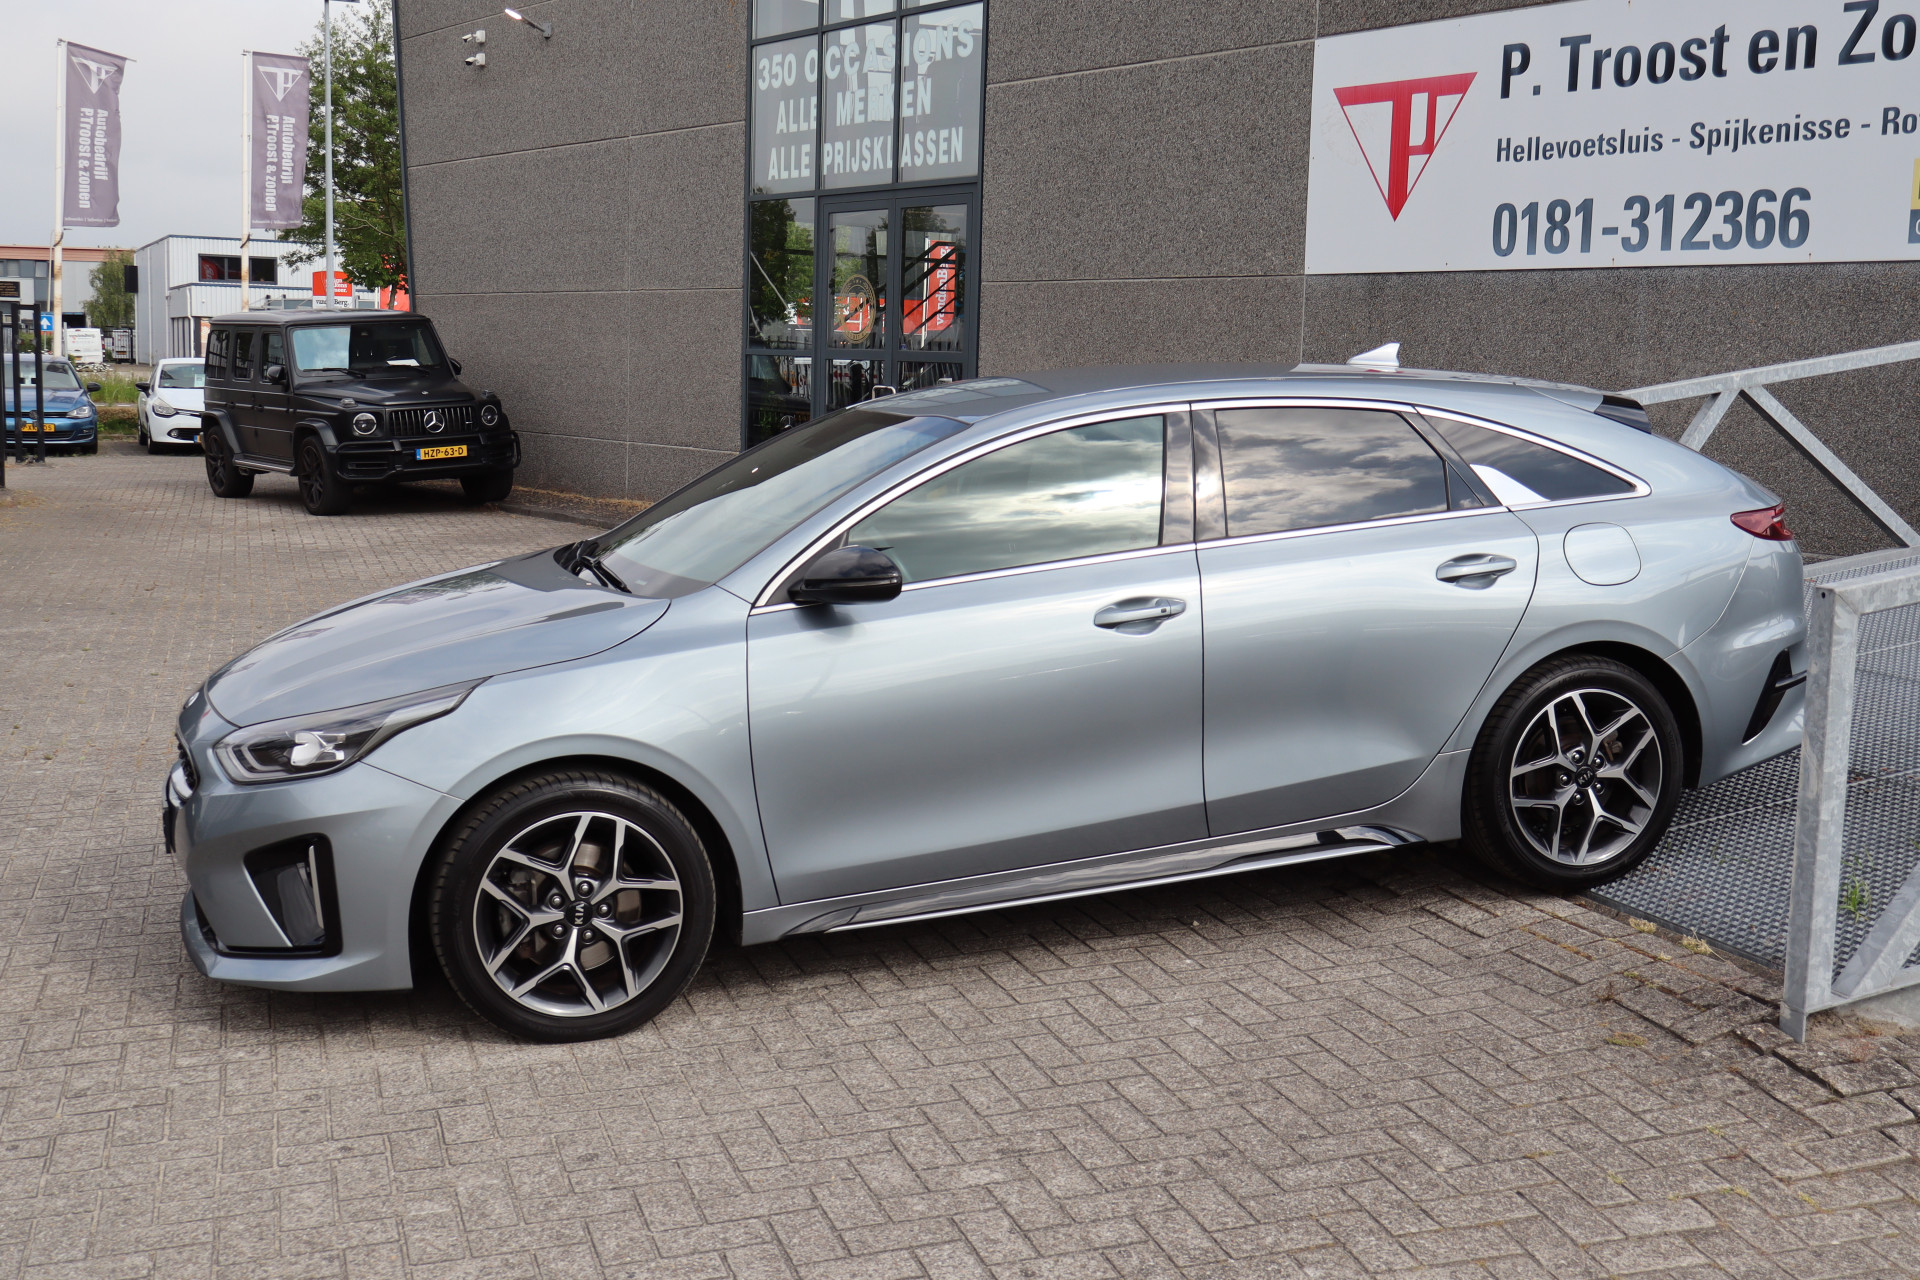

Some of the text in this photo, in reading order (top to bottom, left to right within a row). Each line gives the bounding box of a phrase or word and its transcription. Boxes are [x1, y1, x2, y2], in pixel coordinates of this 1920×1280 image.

[758, 20, 974, 91] 350 OCCASIONS
[1500, 0, 1917, 99] P. Troost en Zo
[776, 78, 932, 135] ALLE MERKEN
[1496, 126, 1663, 162] Hellevoetsluis
[1689, 114, 1850, 155] Spijkenisse
[1881, 106, 1920, 135] Ro
[95, 108, 108, 181] Autobedrijf
[266, 165, 277, 174] &
[282, 115, 295, 184] Autobedrijf
[768, 126, 963, 181] ALLE PRIJSKLASSEN
[265, 175, 277, 212] zonen
[1492, 187, 1811, 257] 0181-312366
[424, 447, 464, 458] HZP-63-D
[1578, 770, 1593, 784] KIA
[574, 903, 585, 925] KIA
